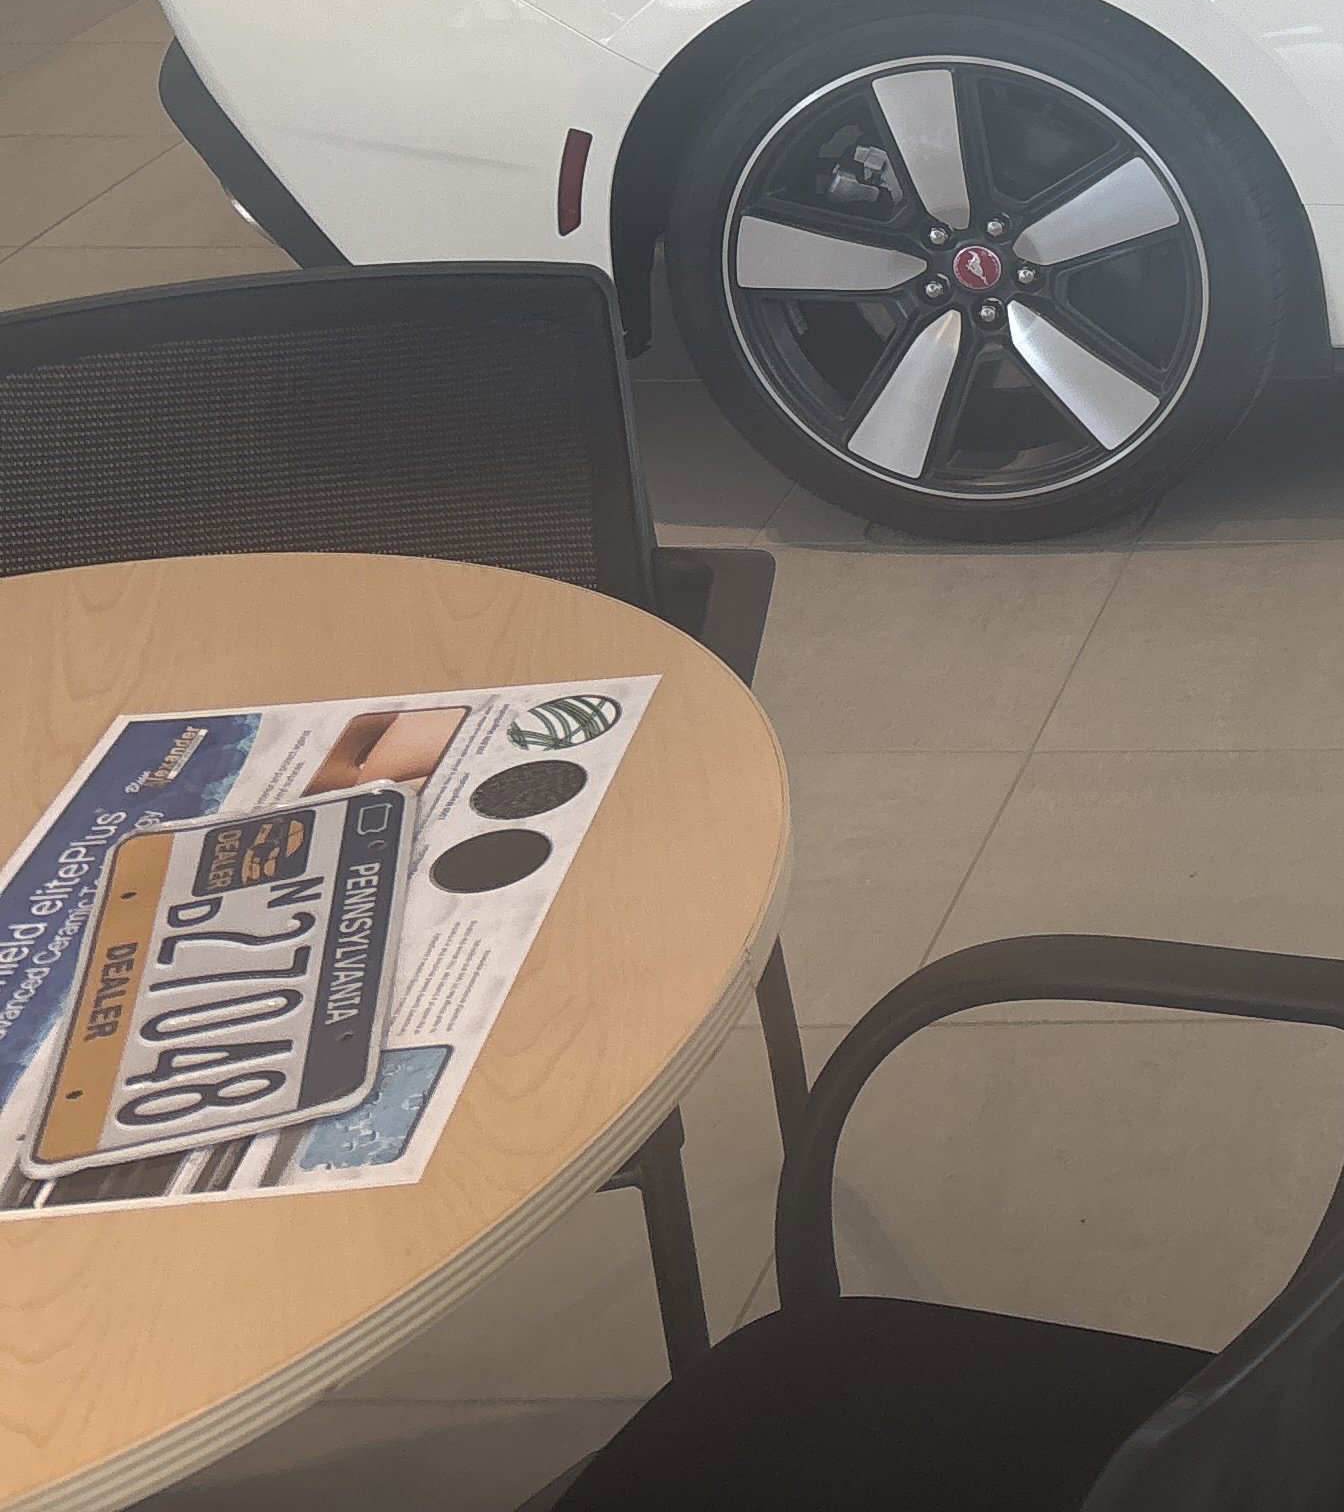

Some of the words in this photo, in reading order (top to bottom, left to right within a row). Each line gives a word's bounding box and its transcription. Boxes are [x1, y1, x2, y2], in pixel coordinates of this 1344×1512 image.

[30, 810, 128, 917] elitePlus
[207, 829, 243, 890] DEALER
[82, 942, 139, 1042] DEALER
[324, 862, 381, 1025] PENNSYLVANIA
